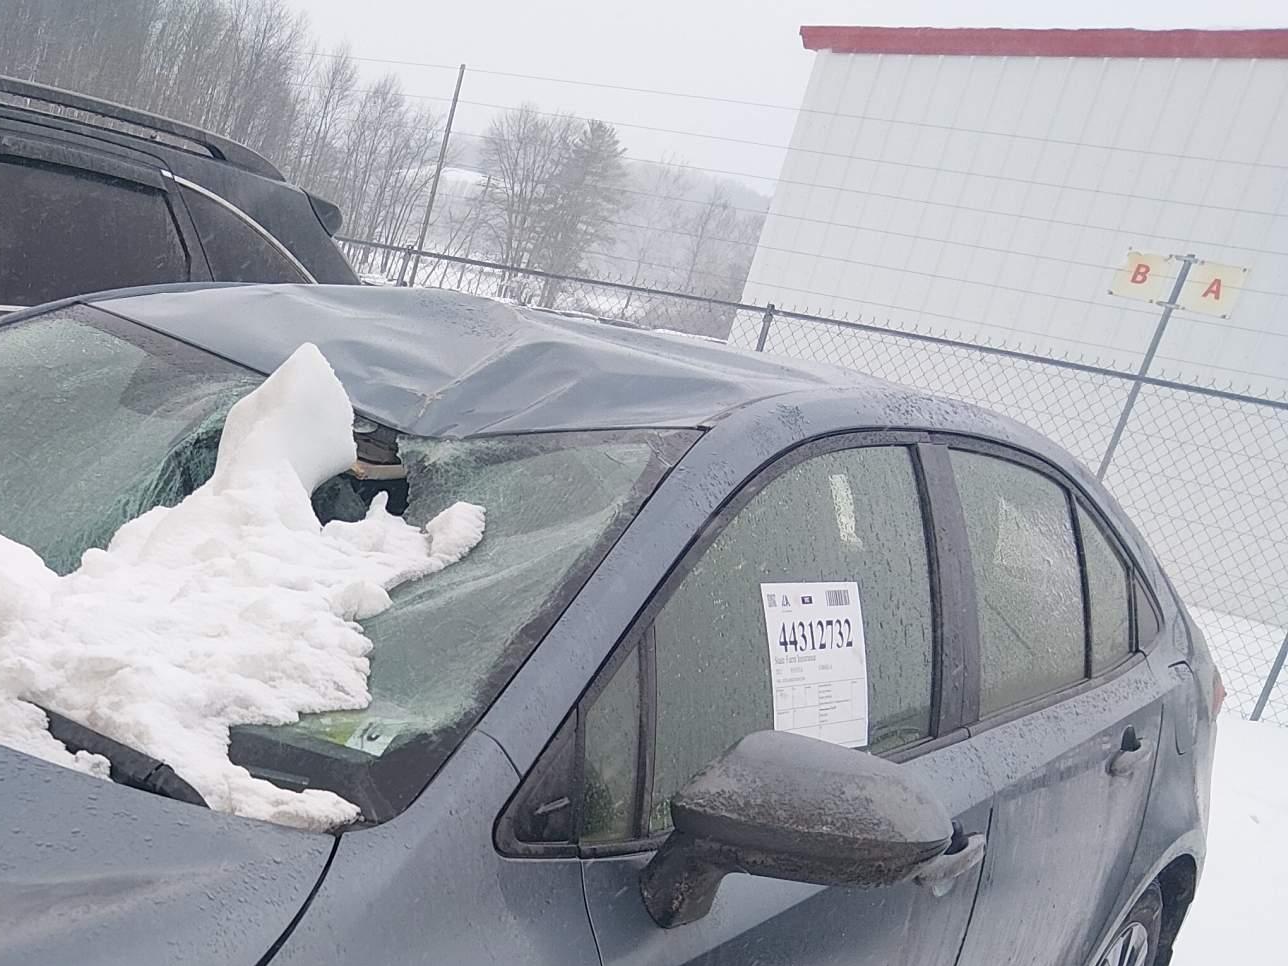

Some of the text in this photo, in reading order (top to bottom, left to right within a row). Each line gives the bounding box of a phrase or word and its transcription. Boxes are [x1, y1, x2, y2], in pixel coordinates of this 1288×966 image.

[1130, 263, 1151, 284] B
[1201, 278, 1222, 300] A
[779, 618, 853, 653] 44312732
